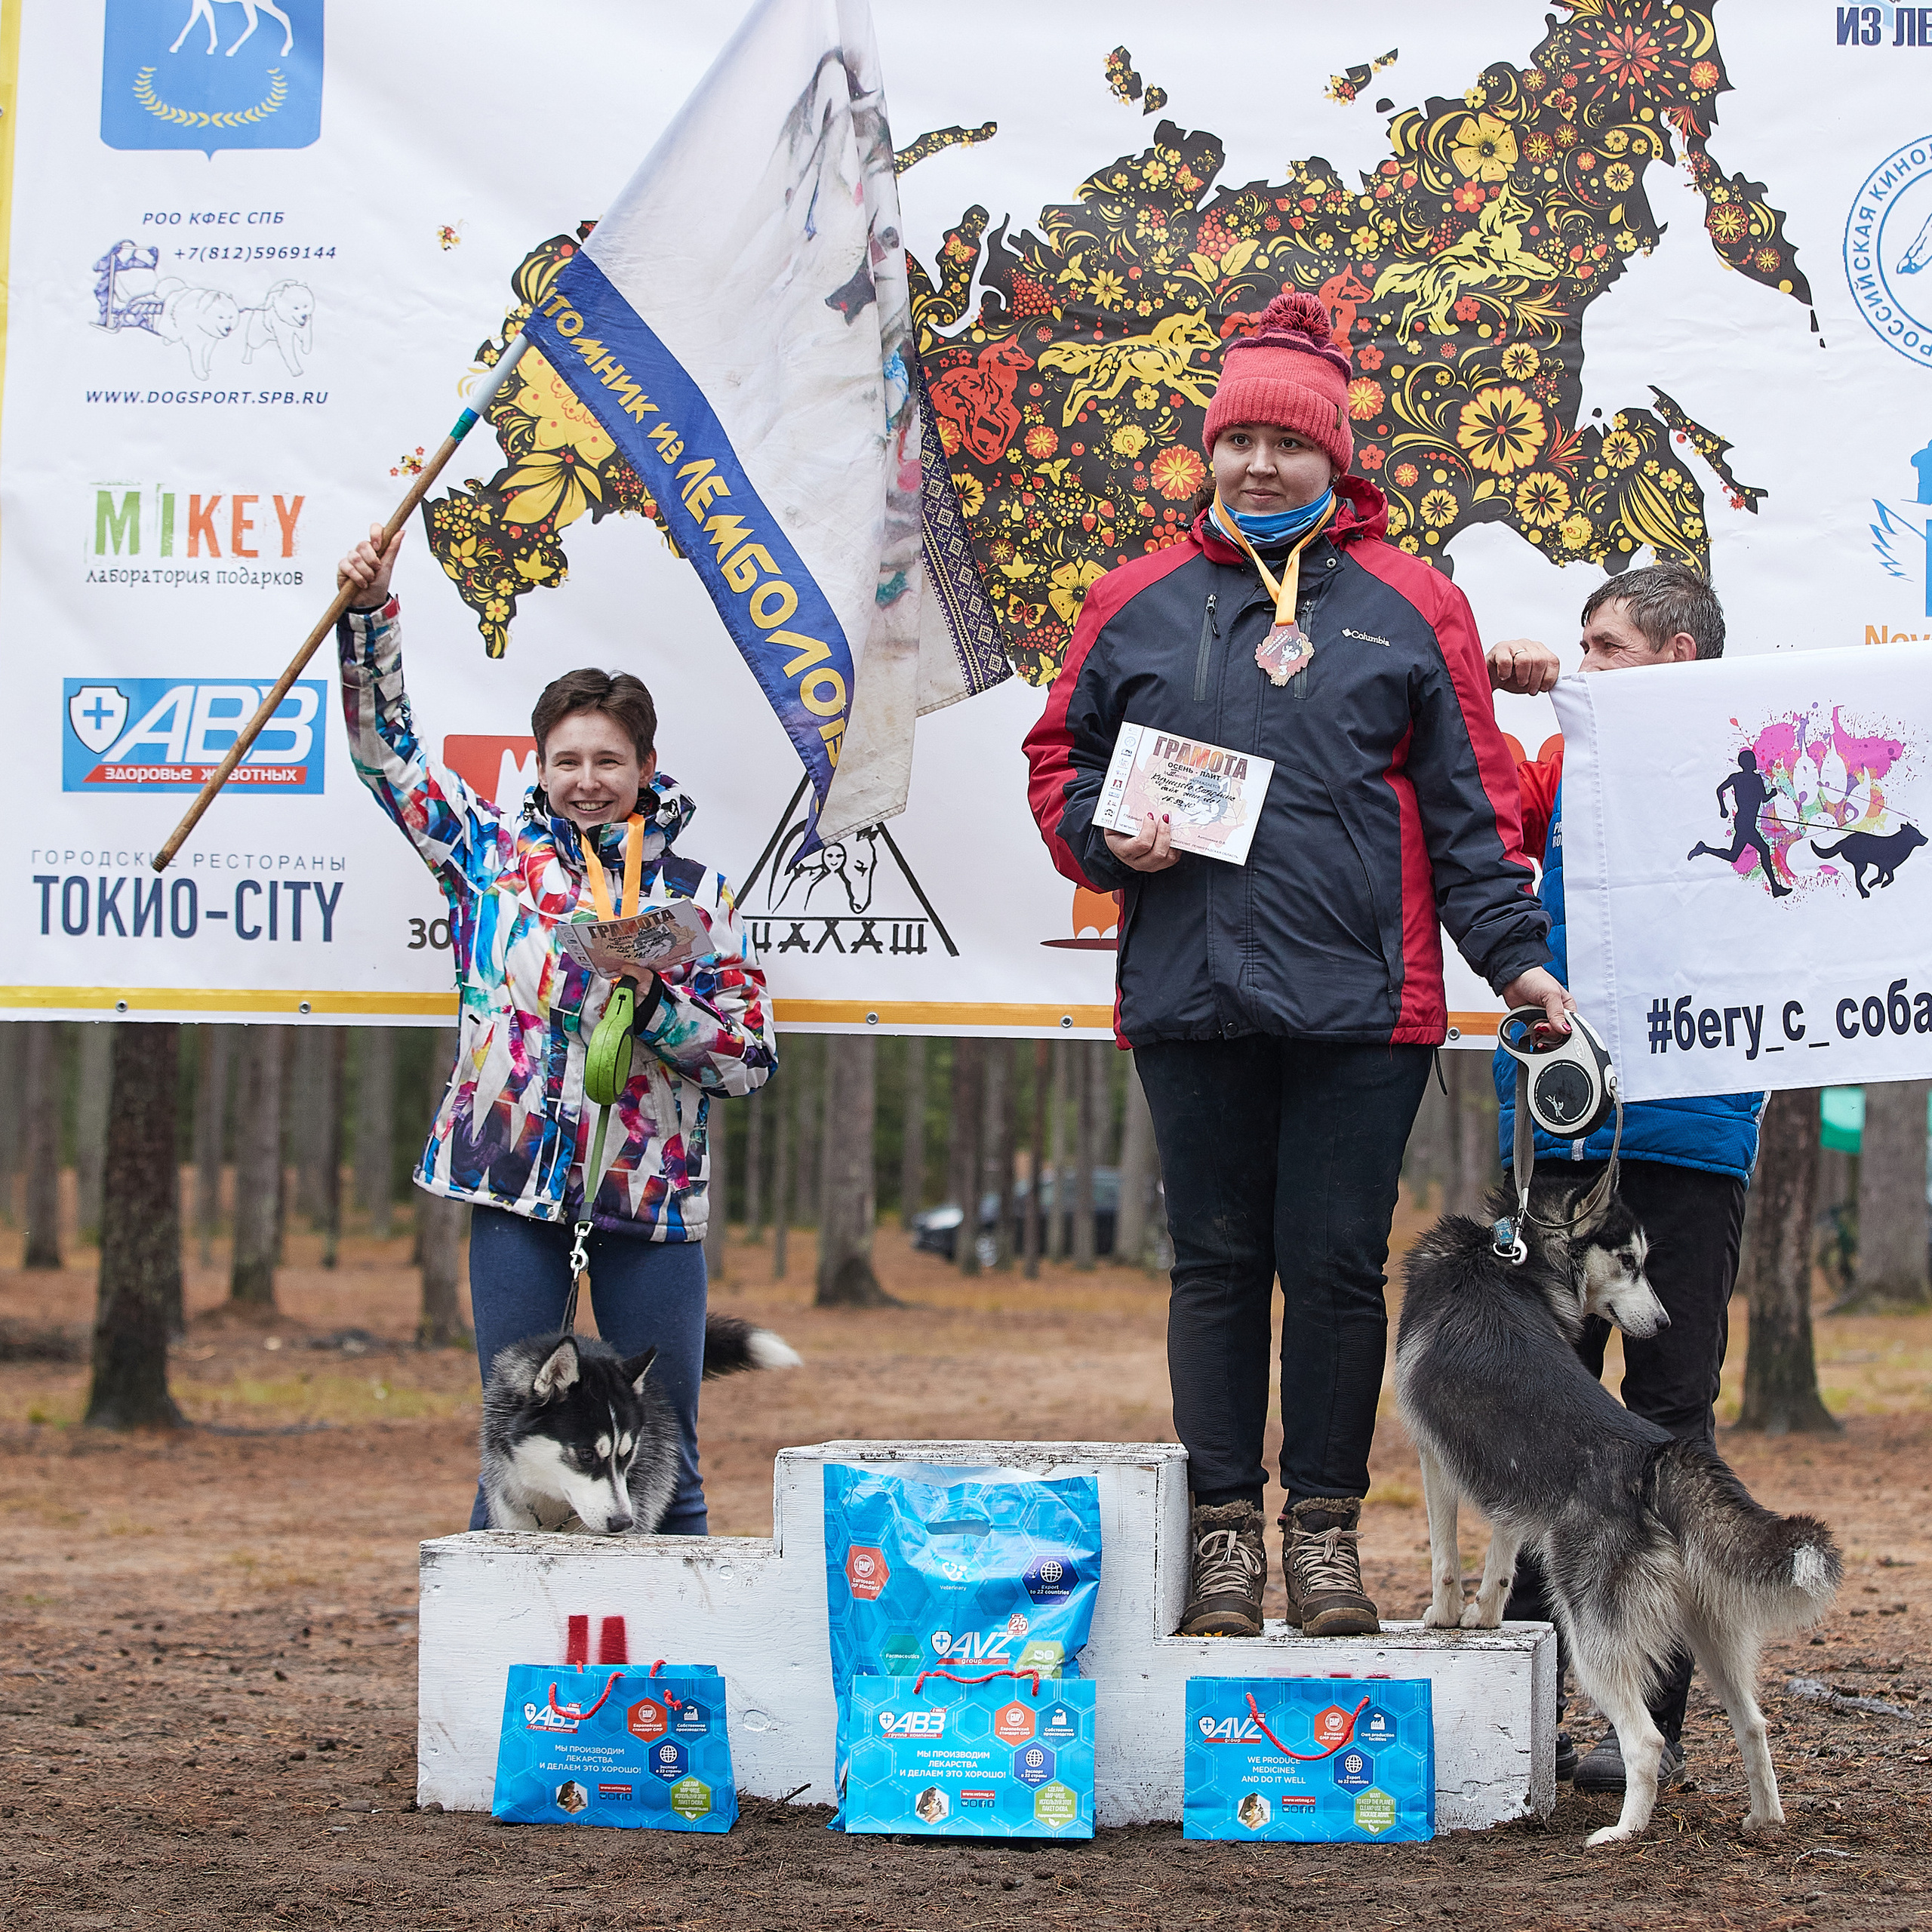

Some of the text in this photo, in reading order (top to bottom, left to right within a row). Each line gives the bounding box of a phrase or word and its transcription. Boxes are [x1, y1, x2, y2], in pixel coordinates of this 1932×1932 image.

[1837, 7, 1881, 46] ИЗ
[143, 211, 285, 225] РОО КФЕС СПБ
[174, 247, 337, 262] +7(812)5969144
[1854, 143, 1932, 358] РОССИЙСКАЯ КИНО
[86, 391, 328, 405] WWW.DOGSPORT.SPB.RU
[647, 422, 685, 465] ИЗ
[95, 490, 306, 558] MIKEY
[86, 567, 303, 589] лаборатория подарков
[1351, 630, 1390, 647] Columbia
[1278, 664, 1287, 675] 3
[1153, 735, 1248, 780] ГРАМОТА
[201, 768, 297, 781] жвотных
[1168, 761, 1194, 774] ОСЕНЬ
[194, 854, 346, 872] РЕСТОРАНЫ
[32, 875, 344, 943] ТОКИО-CITY
[587, 909, 676, 940] ГРАМОТА
[1009, 1617, 1028, 1630] 25
[943, 1632, 1016, 1659] AVZ
[887, 1711, 946, 1733] АВЗ
[1208, 1717, 1266, 1739] AVZ
[555, 1744, 625, 1755] МЫ ПРОИЗВОДИМ
[932, 1751, 990, 1759] ПРОИЗВОДИМ
[566, 1755, 614, 1764] ЛЕКАРСТВА
[928, 1760, 978, 1768] ЛЕКАРСТВА
[1262, 1756, 1301, 1764] PRODUCE
[546, 1762, 580, 1771] ДЕЛАЕМ
[601, 1766, 641, 1774] ХОРОШО!
[907, 1769, 943, 1777] ДЕЛАЕМ
[964, 1770, 1006, 1779] ХОРОШО!
[1252, 1766, 1296, 1774] MEDICINES
